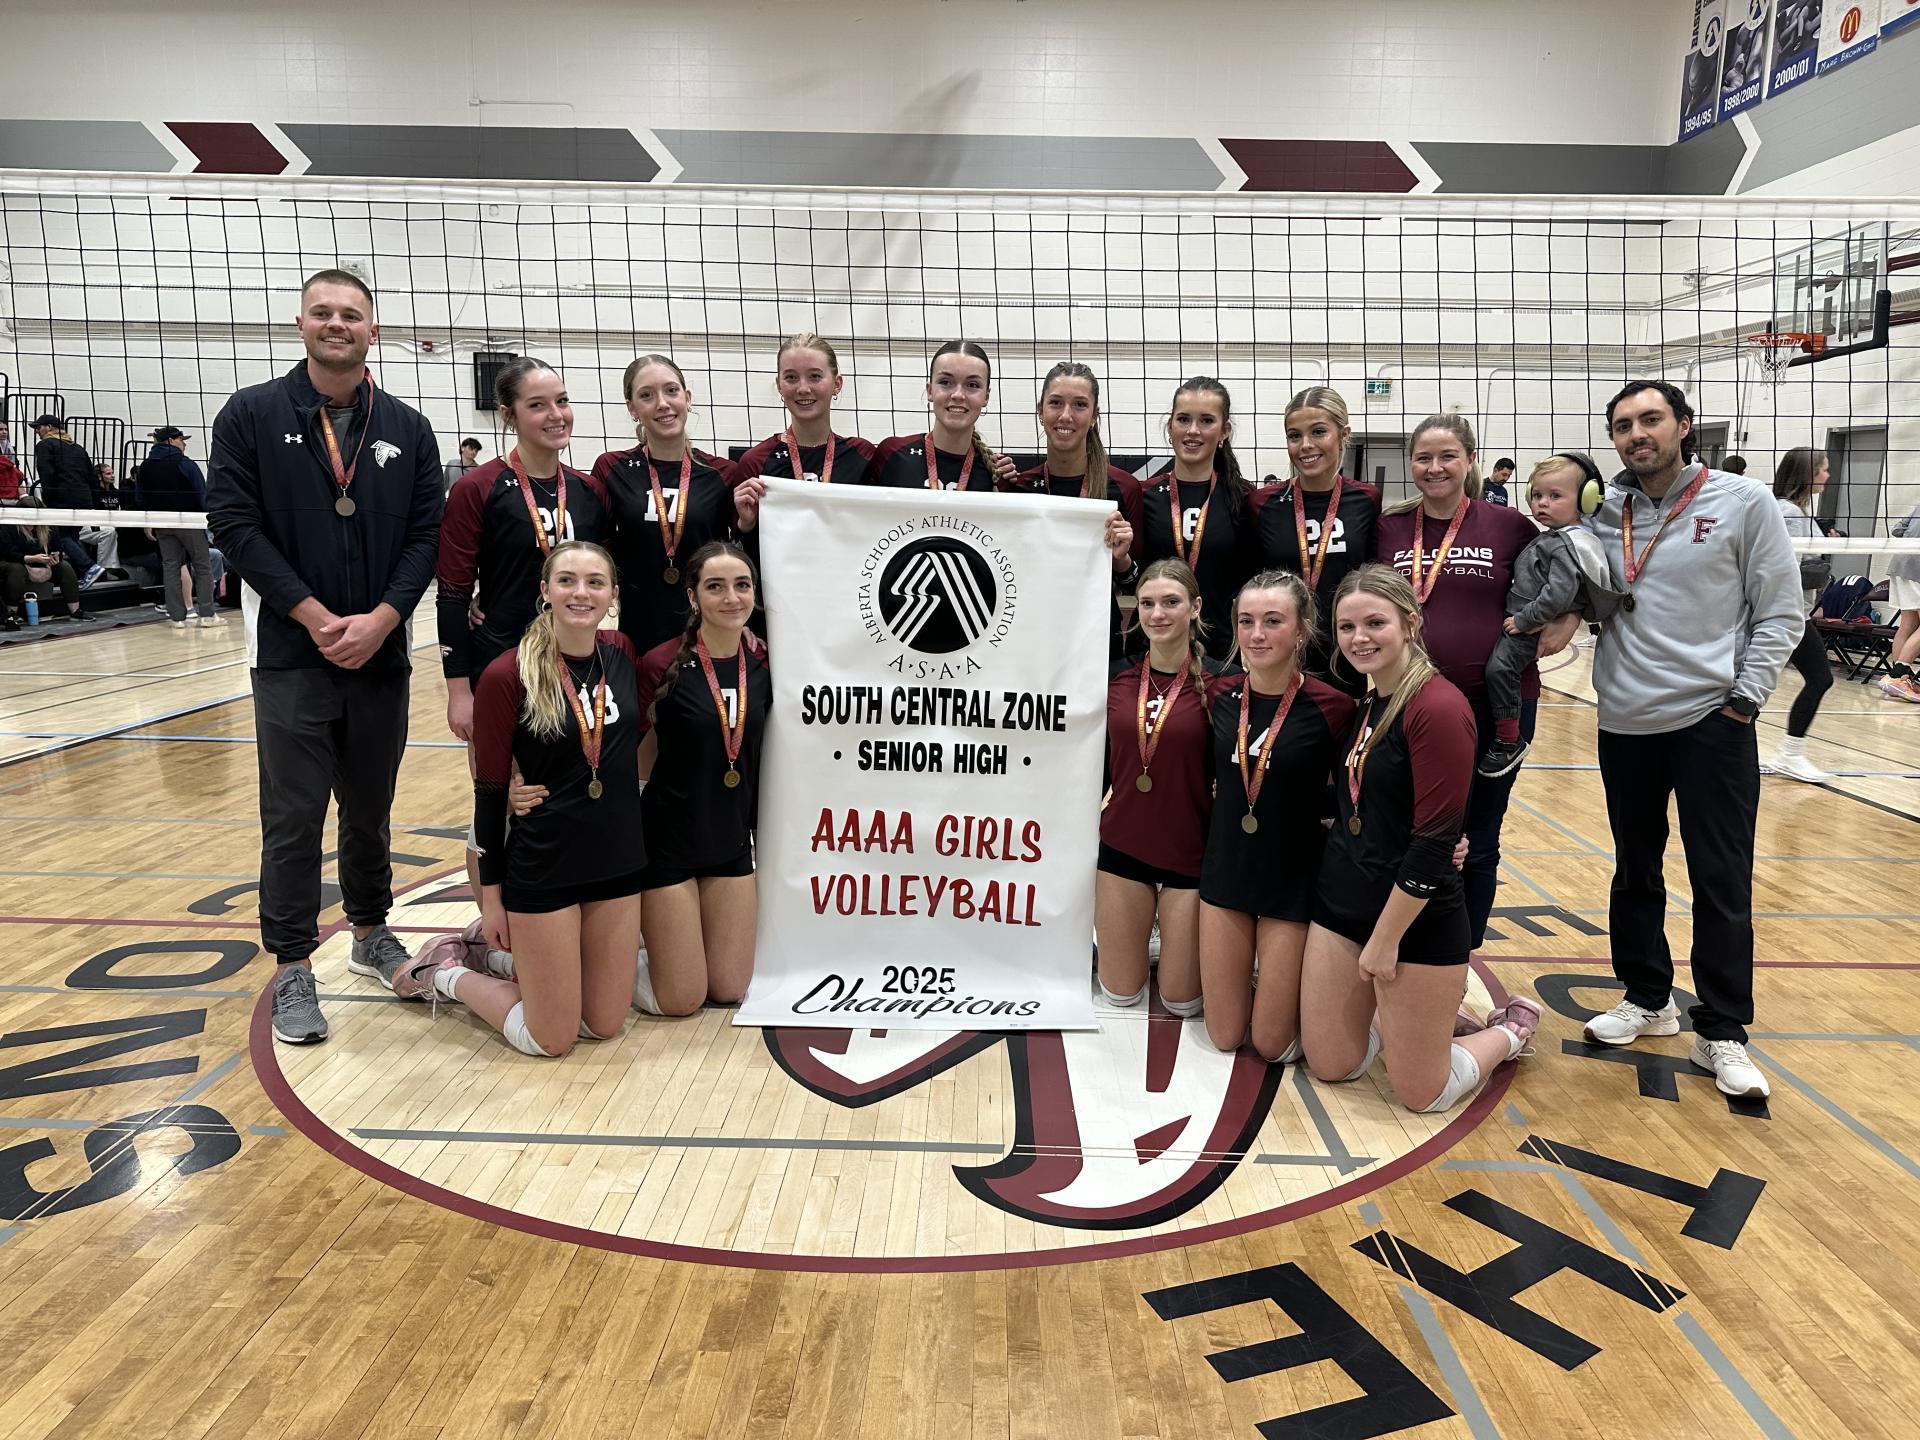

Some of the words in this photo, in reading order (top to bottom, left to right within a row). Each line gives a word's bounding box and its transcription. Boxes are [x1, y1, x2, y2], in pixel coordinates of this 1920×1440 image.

[1774, 57, 1810, 90] 2000/01
[1684, 107, 1712, 134] 1994/95
[644, 487, 680, 523] 17
[1183, 507, 1205, 542] 6
[1303, 517, 1347, 556] 22
[1691, 516, 1718, 545] F
[858, 582, 887, 645] ALBERTA
[921, 515, 994, 547] ATHLETIC
[988, 548, 1018, 649] ASSOCIATION
[801, 684, 883, 725] SOUTH
[890, 685, 996, 728] CENTRAL
[1002, 691, 1067, 732] ZONE
[1146, 699, 1166, 734] 3
[857, 739, 943, 773] SENIOR
[953, 743, 1008, 775] HIGH
[811, 807, 914, 854] AAAA
[935, 814, 1042, 863] GIRLS
[810, 873, 1042, 926] VOLLEYBALL
[791, 973, 1042, 1020] Champions
[881, 965, 956, 995] 2025
[1141, 1133, 1768, 1440] THE
